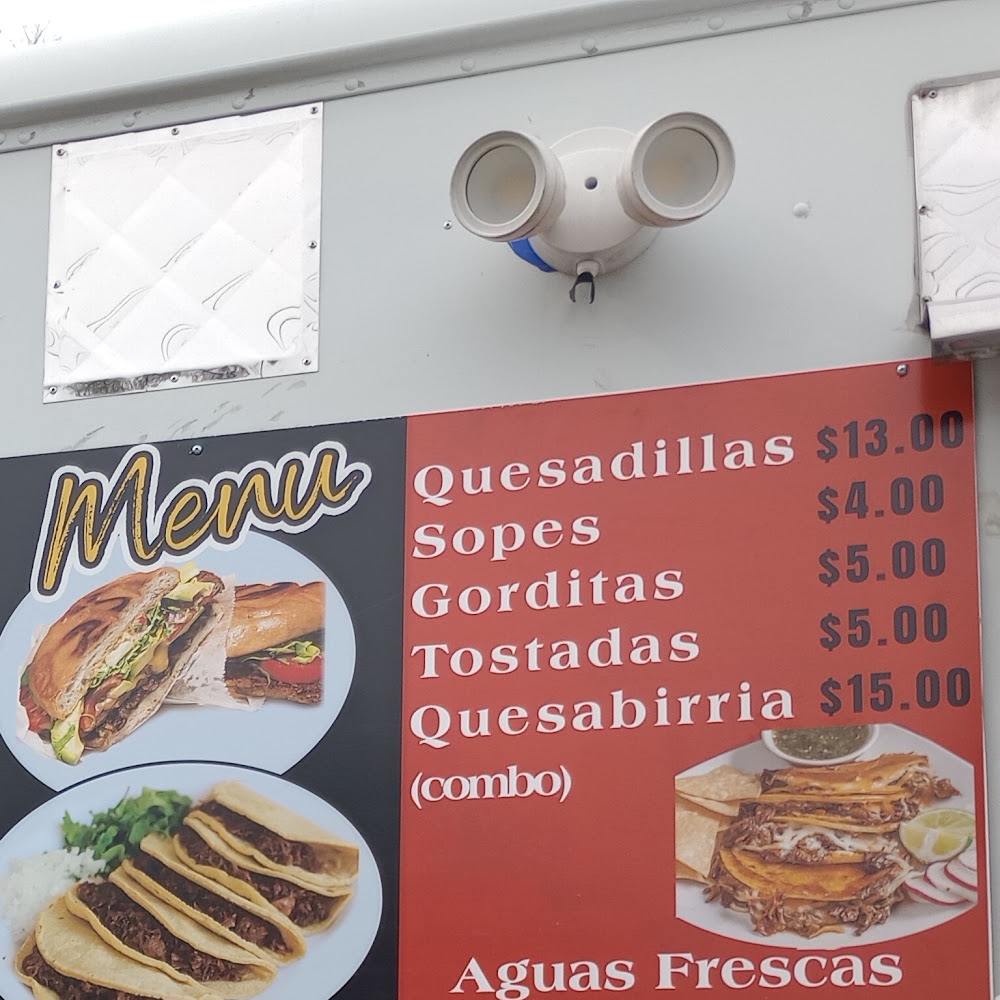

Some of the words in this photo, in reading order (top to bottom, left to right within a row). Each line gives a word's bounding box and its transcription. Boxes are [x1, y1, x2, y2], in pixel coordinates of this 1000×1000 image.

[412, 432, 795, 507] Quesadillas
[816, 410, 965, 463] $13.00
[32, 441, 372, 600] Menu
[411, 514, 602, 562] Sopes
[816, 473, 945, 525] $4.00
[410, 566, 685, 621] Gorditas
[817, 537, 946, 588] $5.00
[410, 626, 701, 680] Tostadas
[818, 602, 948, 651] $5.00
[409, 681, 795, 749] Quesabirria
[819, 666, 972, 718] $15.00
[410, 763, 573, 809] (combo)
[655, 952, 903, 990] Frescas
